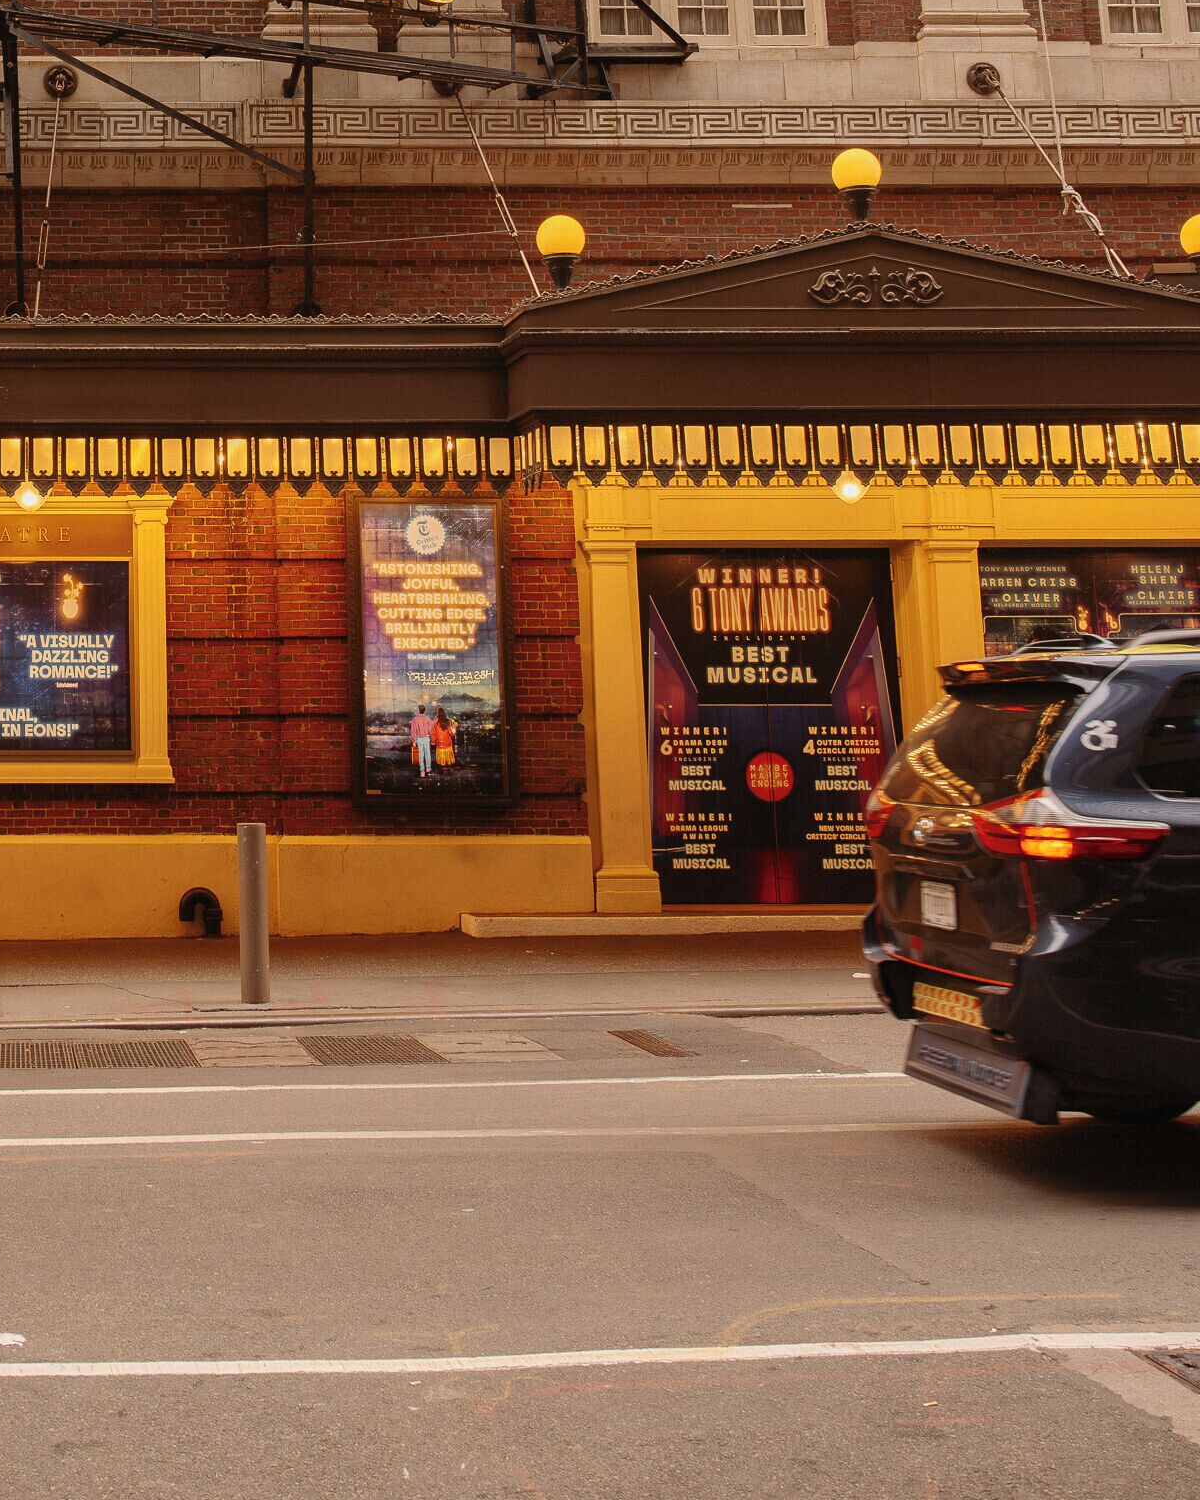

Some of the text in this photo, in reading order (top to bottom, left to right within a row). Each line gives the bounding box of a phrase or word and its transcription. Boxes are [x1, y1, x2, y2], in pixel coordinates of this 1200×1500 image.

[373, 563, 482, 575] “ASTONISHING.
[1131, 565, 1184, 574] HELEN J
[698, 568, 820, 584] WINNER!
[1140, 575, 1178, 584] SHEN
[403, 578, 459, 591] JOYFUL,
[980, 578, 1077, 587] ARREN CRISS
[373, 592, 490, 607] HEARTBREAKING,
[1002, 593, 1060, 603] OLIVER
[1137, 591, 1194, 600] CLAIRE
[377, 608, 486, 619] CUTTING EDGE.
[692, 587, 829, 632] 6 TONY AWARDS
[385, 622, 475, 634] BRILLIANTLY
[19, 634, 115, 648] “A VISUALLY
[393, 637, 475, 649] EXECUTED.”
[31, 650, 109, 663] DAZZLING
[731, 646, 789, 663] BEST
[29, 665, 119, 679] ROMANCE!”
[707, 667, 817, 683] MUSICAL
[1, 723, 20, 737] IN
[24, 723, 79, 737] EONS!”
[660, 727, 727, 735] WINNER!
[808, 726, 874, 735] WINNER!
[661, 740, 673, 755] 6
[803, 739, 815, 755] 4
[681, 766, 711, 776] BEST
[827, 765, 857, 776] BEST
[669, 780, 726, 791] MUSICAL
[815, 780, 872, 791] MUSICAL
[665, 813, 732, 821] WINNER!
[814, 813, 863, 821] WINNE
[685, 844, 716, 854] BEST
[835, 844, 865, 854] BEST
[673, 858, 731, 869] MUSICAL
